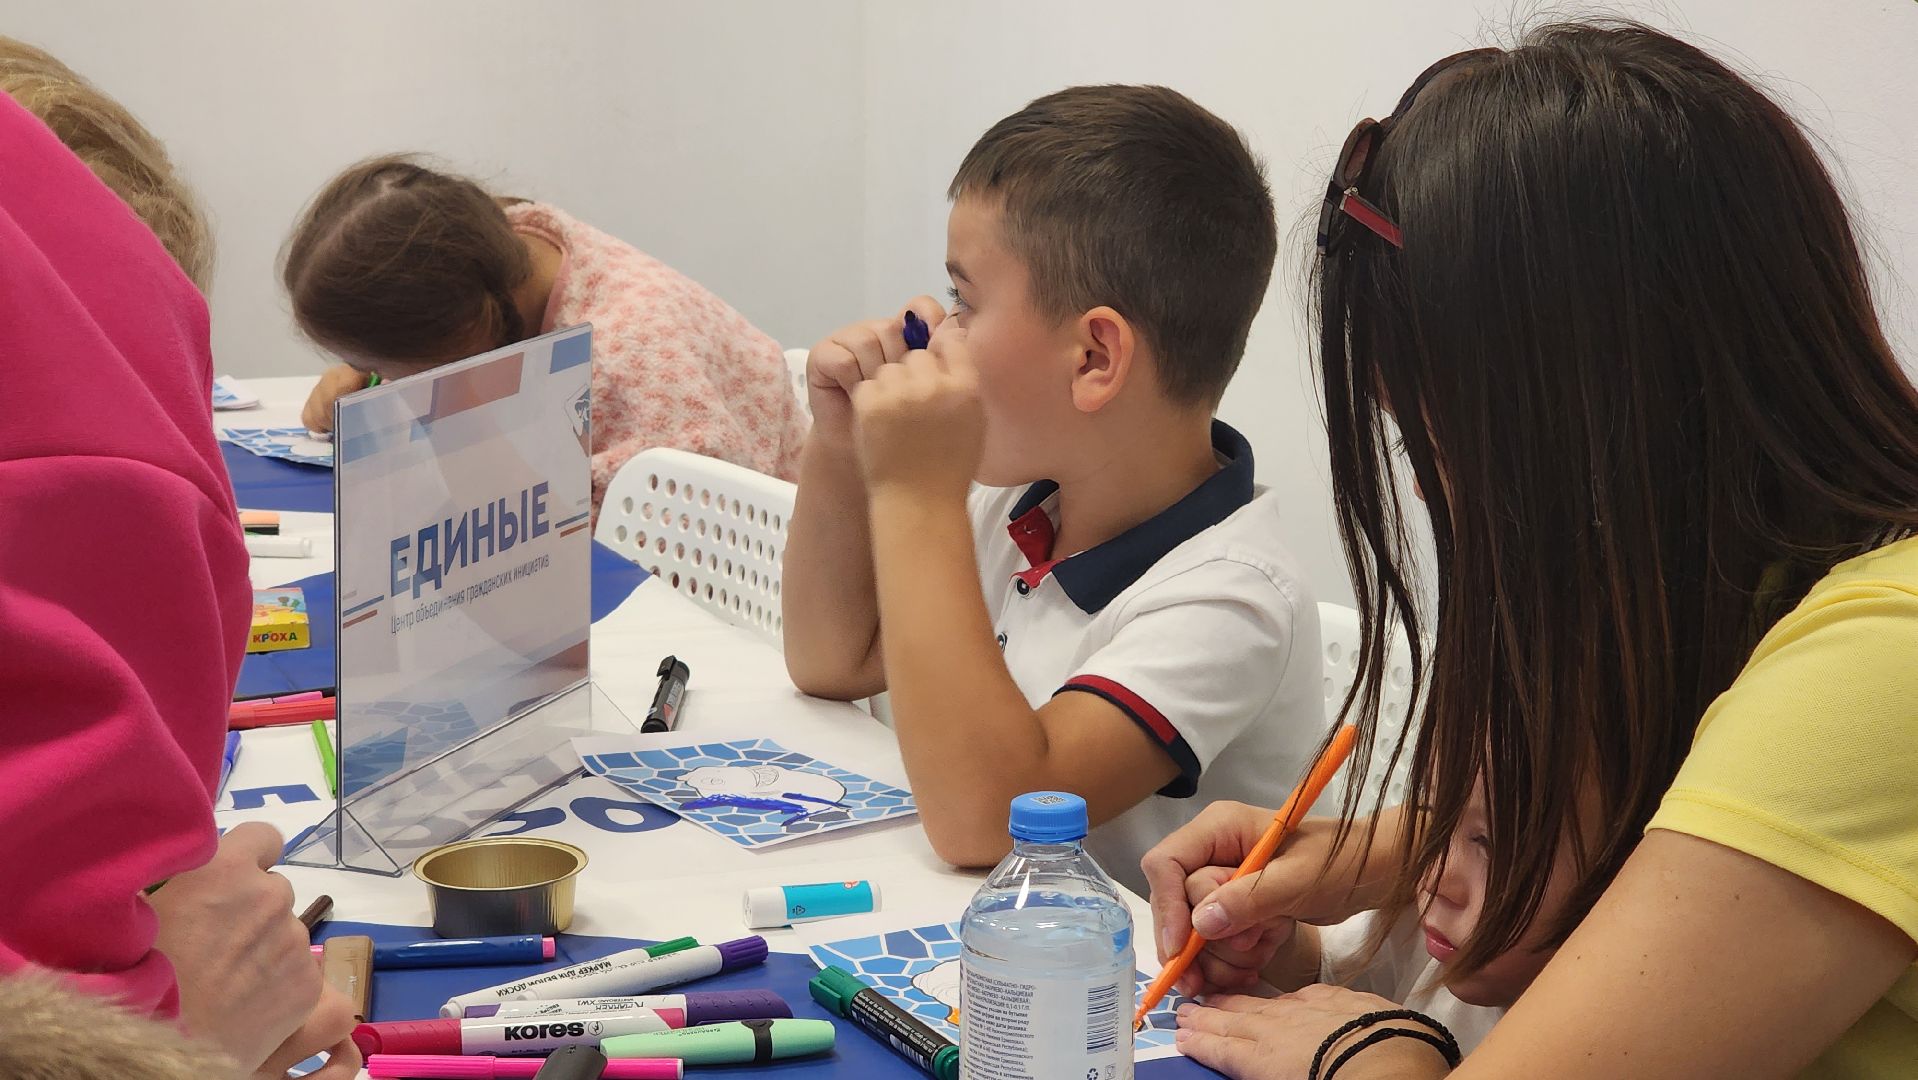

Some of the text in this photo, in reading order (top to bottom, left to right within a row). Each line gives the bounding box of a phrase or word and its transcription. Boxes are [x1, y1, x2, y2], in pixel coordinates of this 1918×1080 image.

[390, 481, 549, 600] ЕДИНЫЕ
[391, 607, 414, 636] Центр
[465, 572, 512, 604] гражданских
[513, 554, 550, 583] инициатив
[253, 632, 298, 643] КРОХА
[579, 960, 612, 976] МАРКЕР
[496, 983, 527, 998] ДОСКИ
